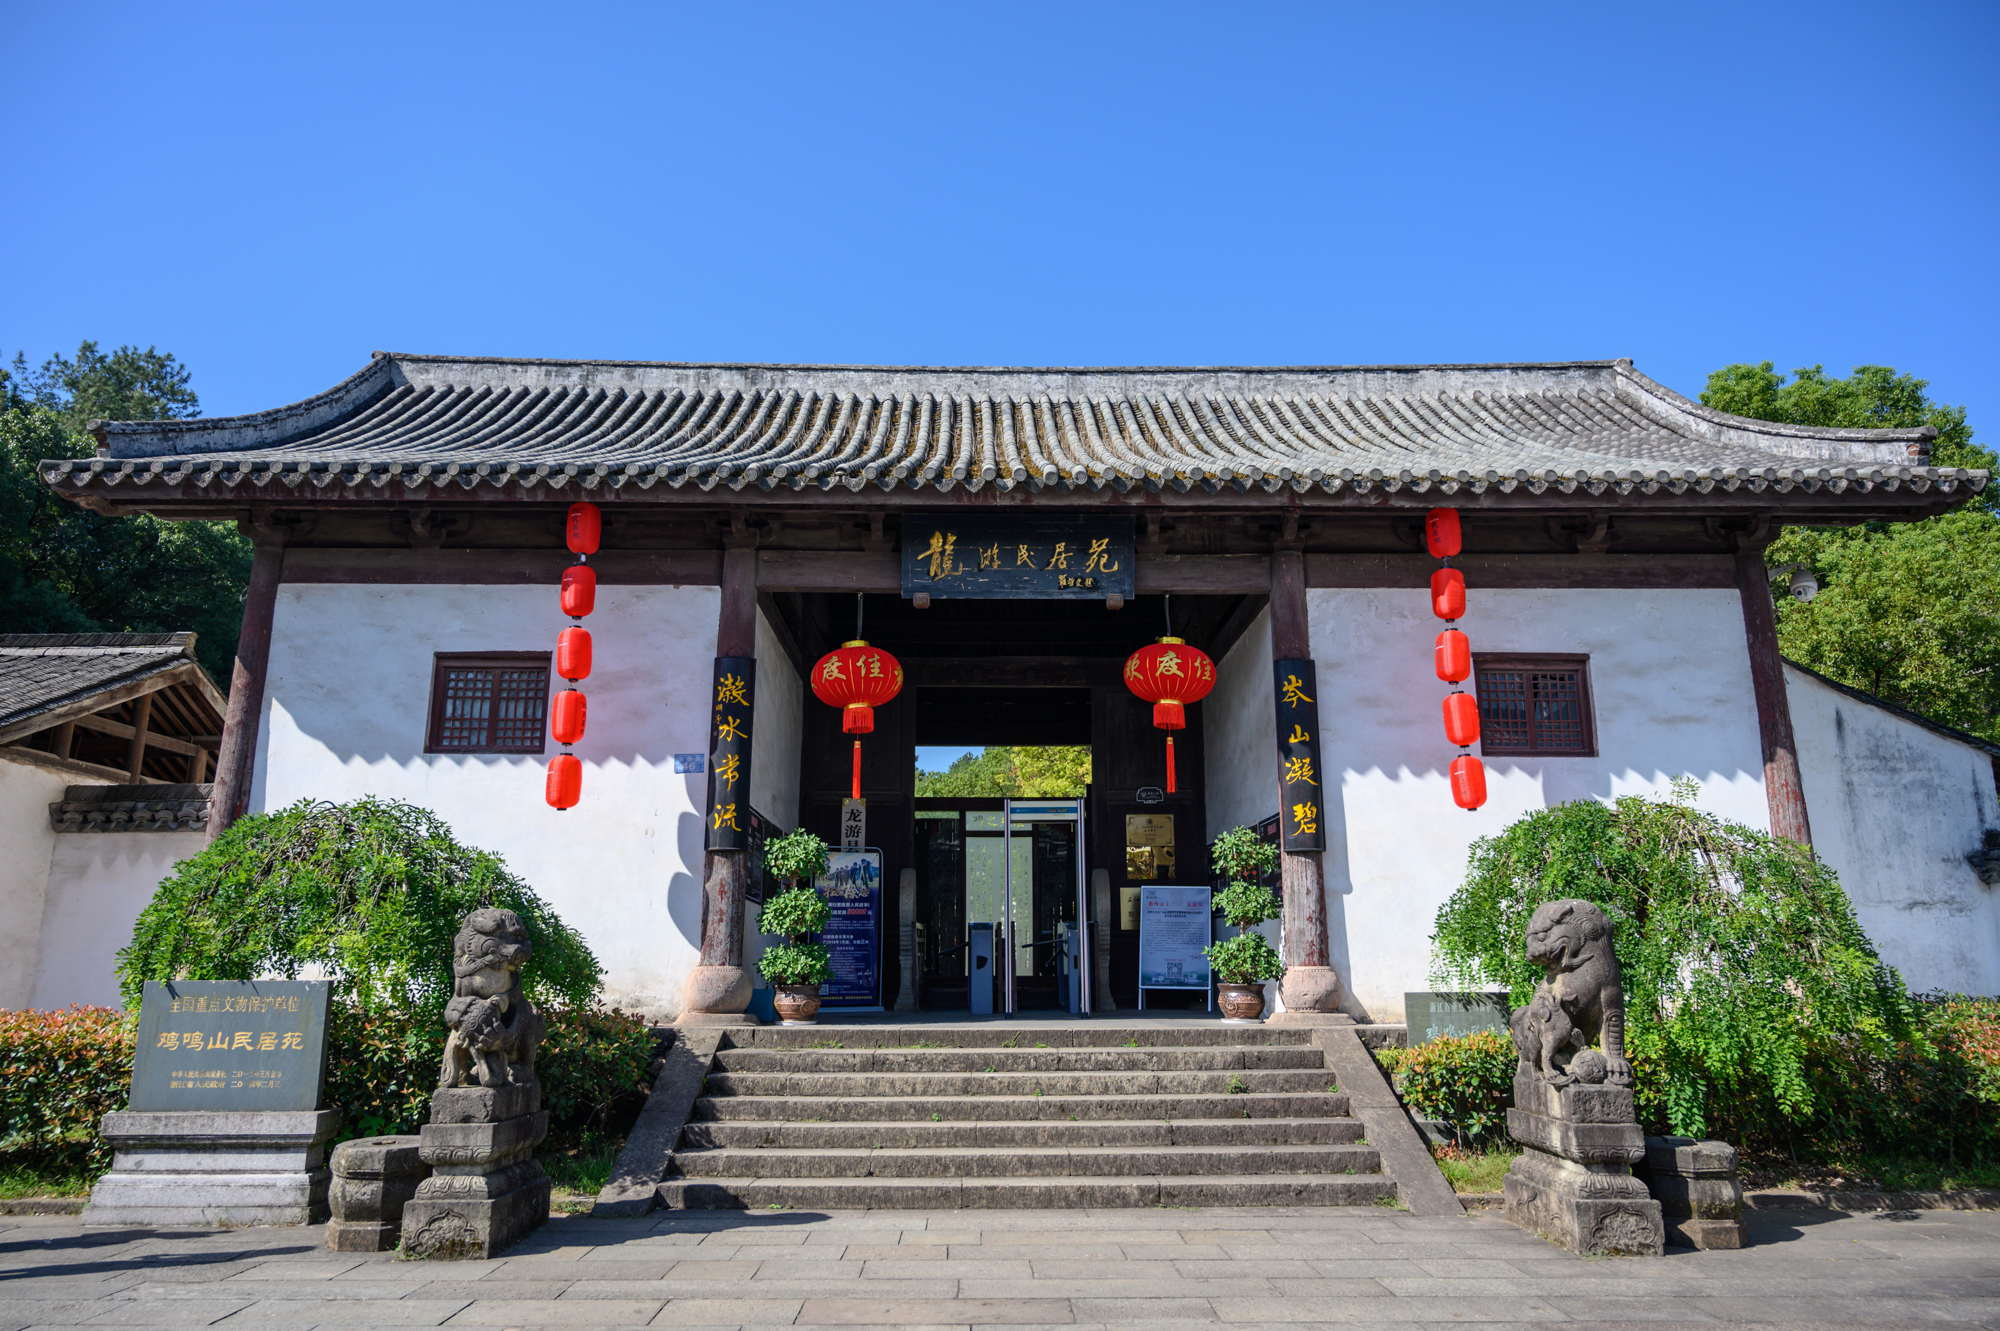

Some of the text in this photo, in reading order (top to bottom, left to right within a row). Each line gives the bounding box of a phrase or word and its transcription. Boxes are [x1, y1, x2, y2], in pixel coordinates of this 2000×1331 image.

[682, 762, 696, 771] 46
[169, 996, 300, 1013] 全国重点文物保护单位
[156, 1031, 305, 1051] 鸡鸣山民居苑
[169, 1080, 226, 1089] 浙江省人民政府
